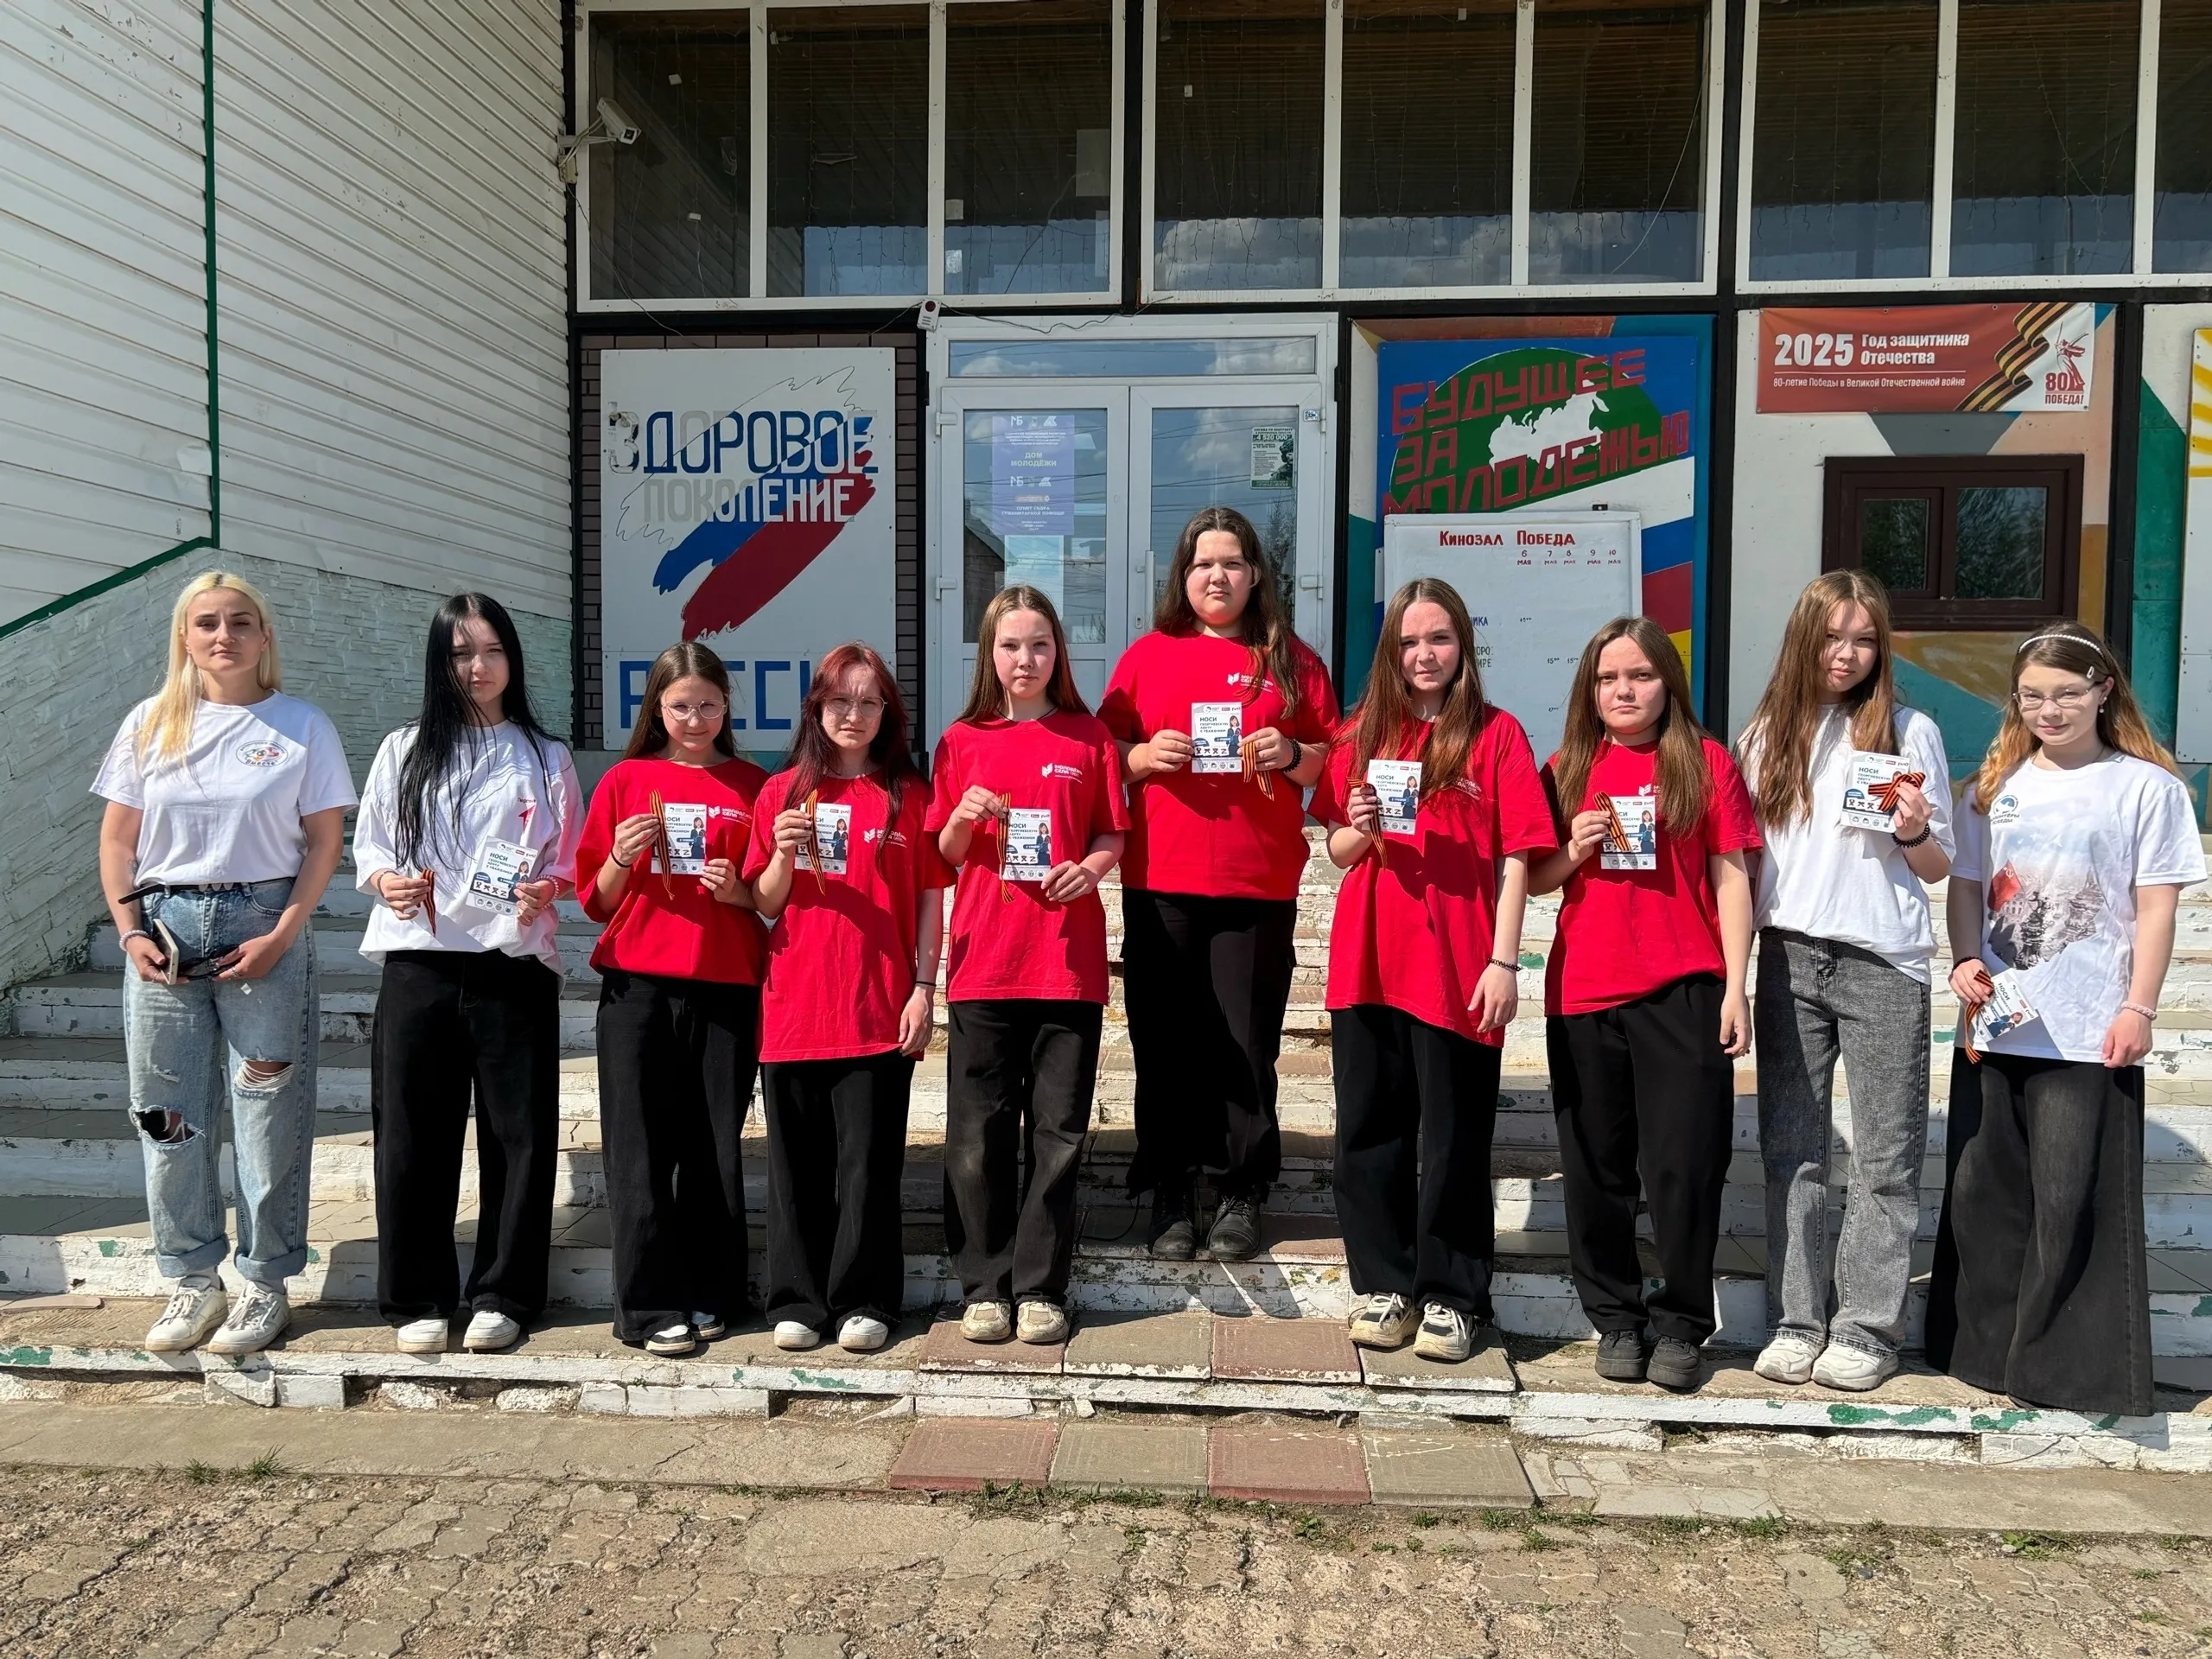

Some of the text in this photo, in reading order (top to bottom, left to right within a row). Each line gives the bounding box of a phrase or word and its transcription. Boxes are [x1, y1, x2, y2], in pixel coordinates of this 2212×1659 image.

[1774, 334, 1970, 366] 2025 Год защитника
[1860, 350, 1936, 365] Отечества
[1773, 378, 1808, 387] 80-летие
[1808, 378, 1838, 388] Победы
[1847, 378, 1879, 388] Великой
[1881, 378, 1940, 387] Отечественной
[1942, 377, 1966, 387] войне
[2045, 372, 2068, 391] 80
[2044, 394, 2084, 405] ПОБЕДА!
[607, 410, 880, 474] ЗДОРОВОЕ
[1395, 428, 1458, 485] ЗА
[644, 478, 855, 524] ПОКОЛЕНИЕ
[1471, 616, 1488, 626] ИКА
[489, 852, 509, 861] НОСИ
